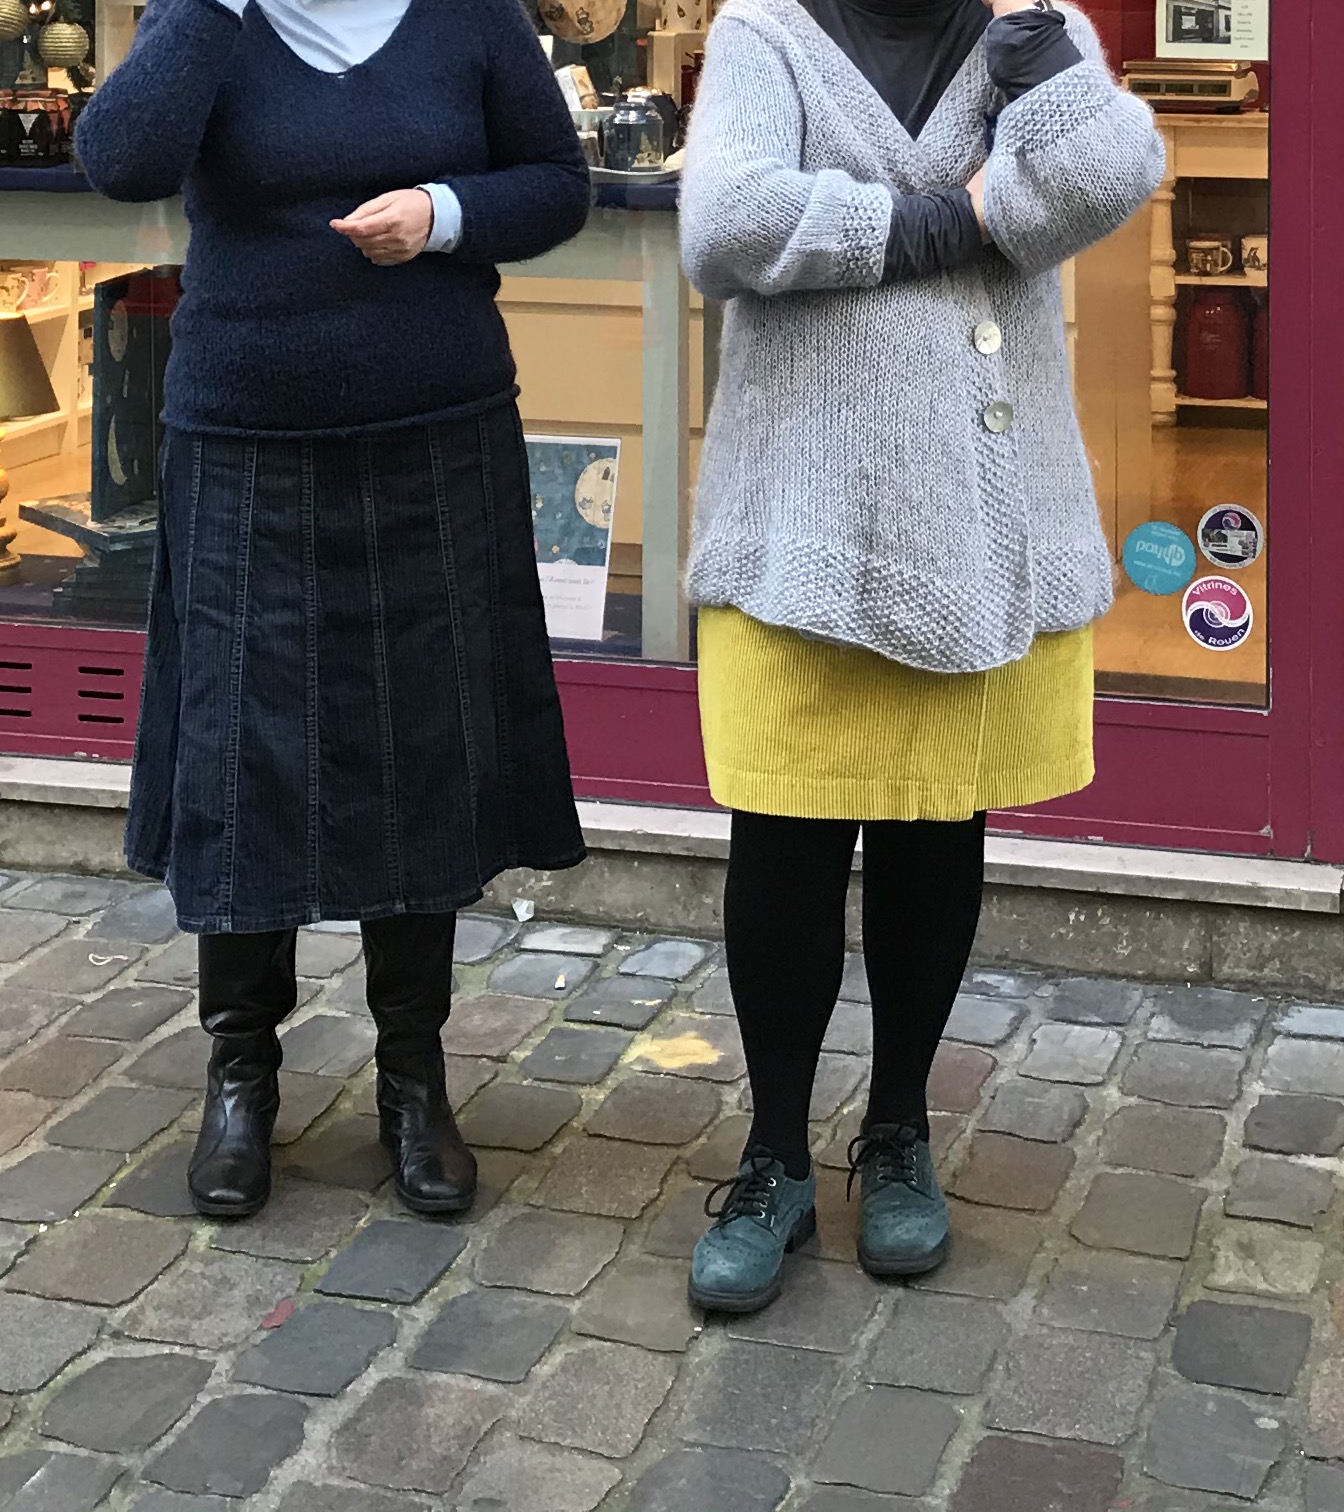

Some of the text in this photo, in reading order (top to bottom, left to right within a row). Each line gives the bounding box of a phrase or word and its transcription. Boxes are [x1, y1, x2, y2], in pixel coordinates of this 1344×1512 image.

[1192, 580, 1238, 596] Vitrines
[1194, 628, 1245, 646] de Rouen
